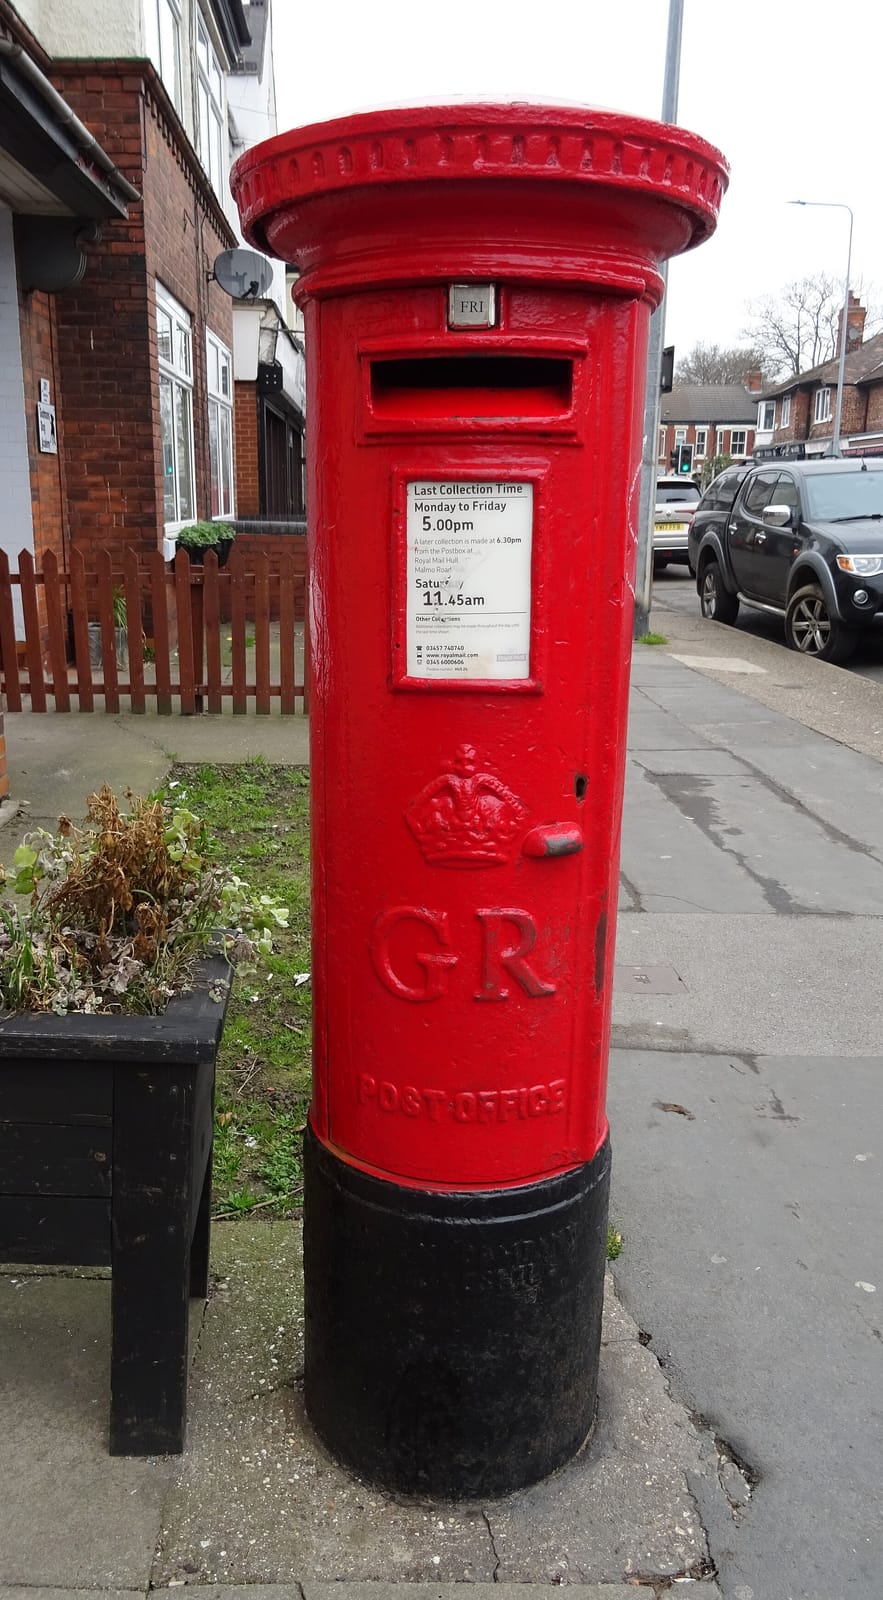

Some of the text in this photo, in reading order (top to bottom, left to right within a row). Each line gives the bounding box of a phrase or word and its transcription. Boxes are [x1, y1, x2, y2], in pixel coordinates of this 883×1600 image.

[460, 301, 484, 313] FRI
[414, 483, 523, 496] Last Collection Time
[414, 501, 506, 513] Monday to Friday
[422, 516, 474, 533] 5.00pm
[414, 557, 431, 565] Royal
[415, 578, 464, 590] Satu
[423, 591, 485, 606] 11.45am
[357, 1072, 566, 1123] POST OFFICE
